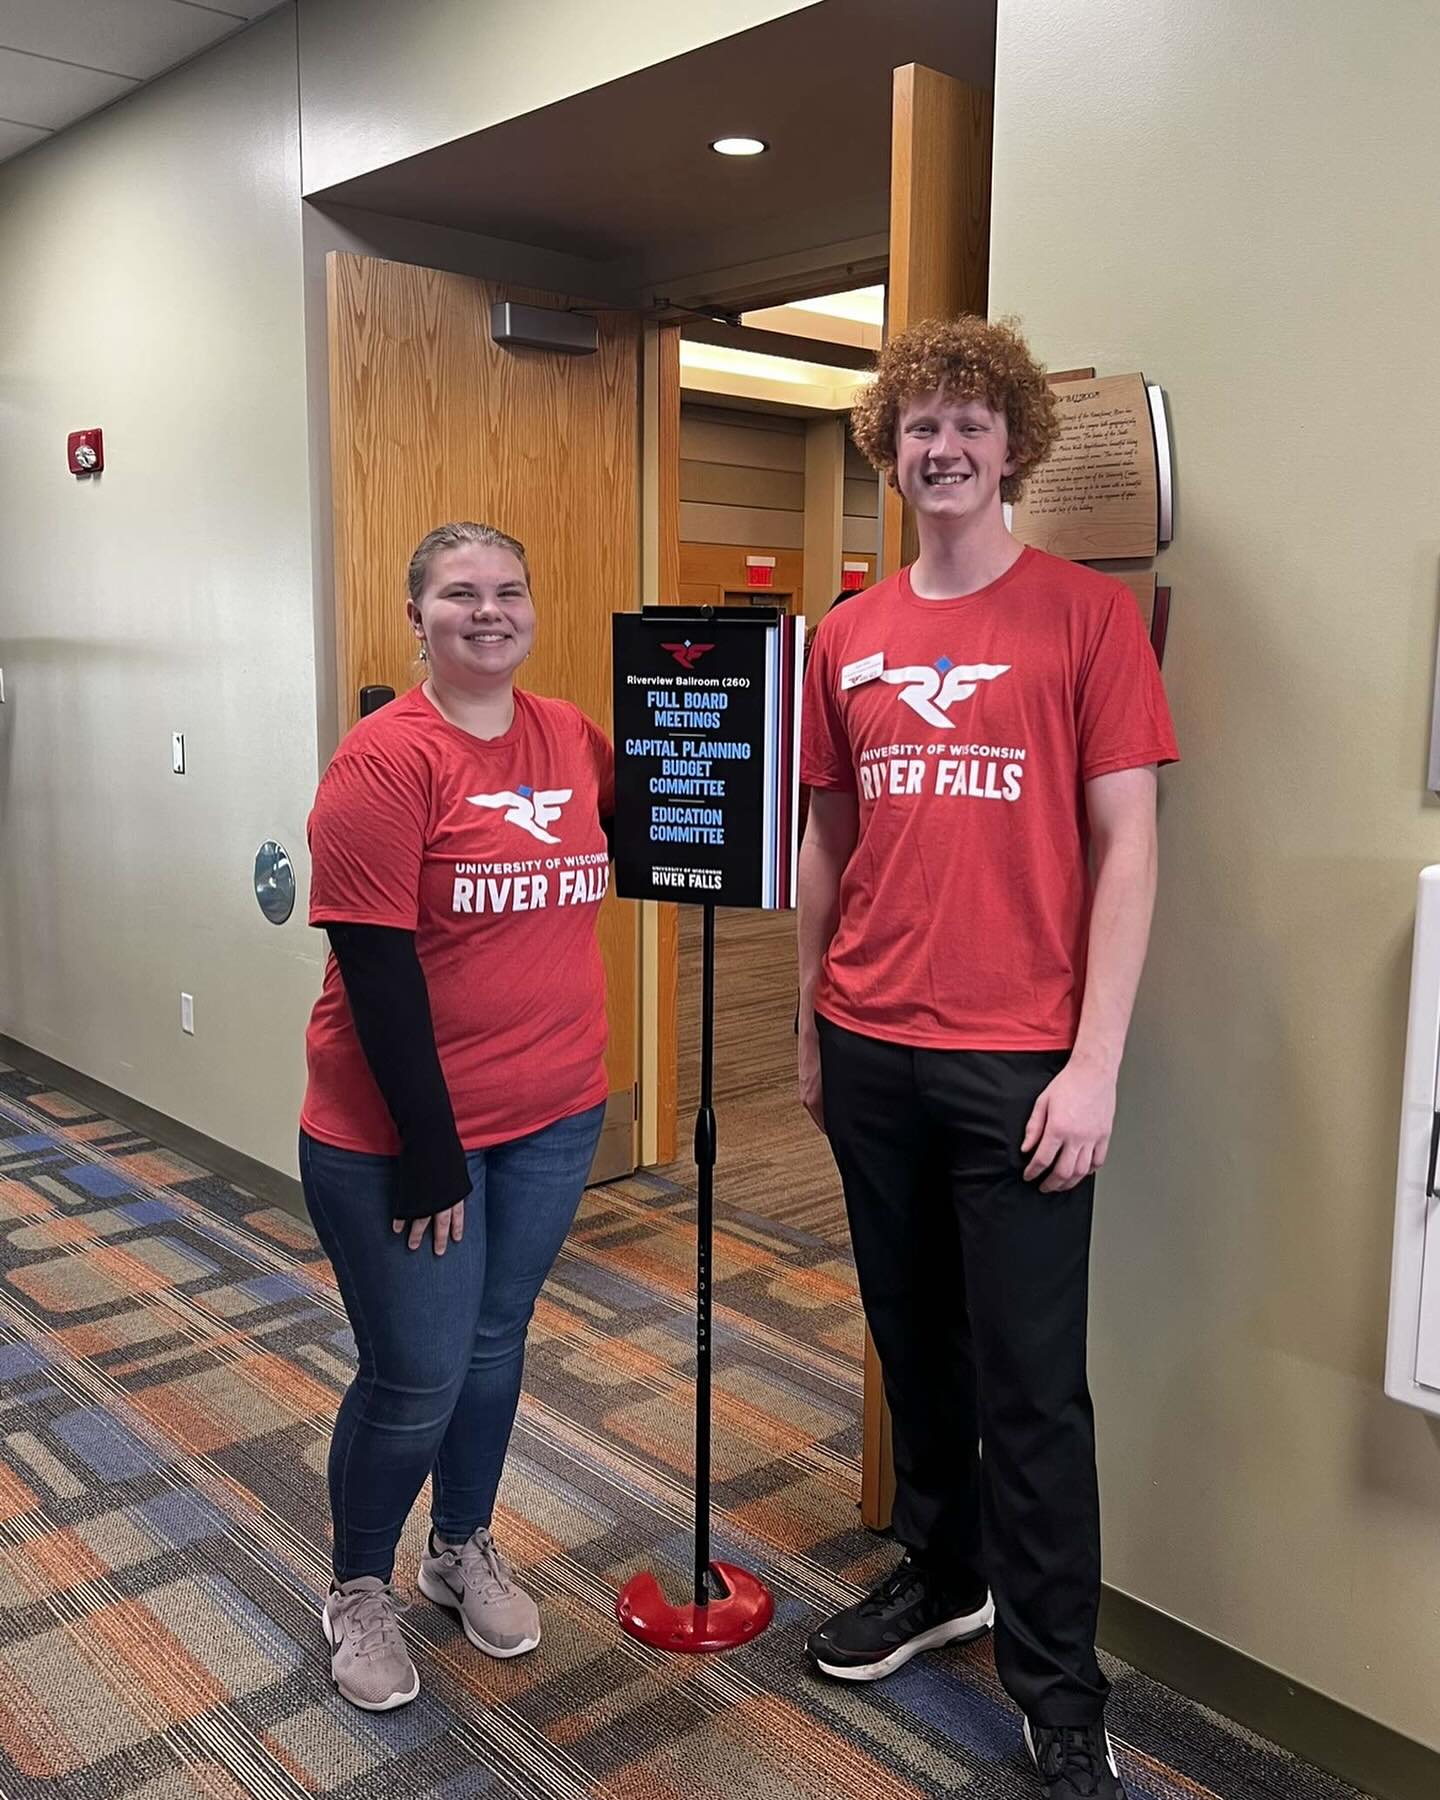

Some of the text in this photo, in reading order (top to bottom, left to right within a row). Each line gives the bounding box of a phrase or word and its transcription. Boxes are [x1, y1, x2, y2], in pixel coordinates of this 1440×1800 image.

[627, 675, 751, 689] Riverview Ballroom (260)
[647, 691, 728, 710] FULL BOARD
[654, 710, 721, 729] MEETINGS
[625, 738, 751, 760] CAPITAL PLANNING
[860, 744, 924, 763] NIVESITY
[927, 744, 945, 756] OF
[662, 759, 713, 777] BUDGET
[649, 777, 726, 797] COMMITTEE
[934, 759, 1024, 802] FALLS
[651, 806, 723, 826] EDUCATION
[649, 825, 725, 845] COMMITTEE
[455, 859, 542, 875] UNIVERSITY
[545, 857, 561, 870] OF
[652, 871, 722, 890] RIVER FALLS
[452, 874, 548, 914] RIVER
